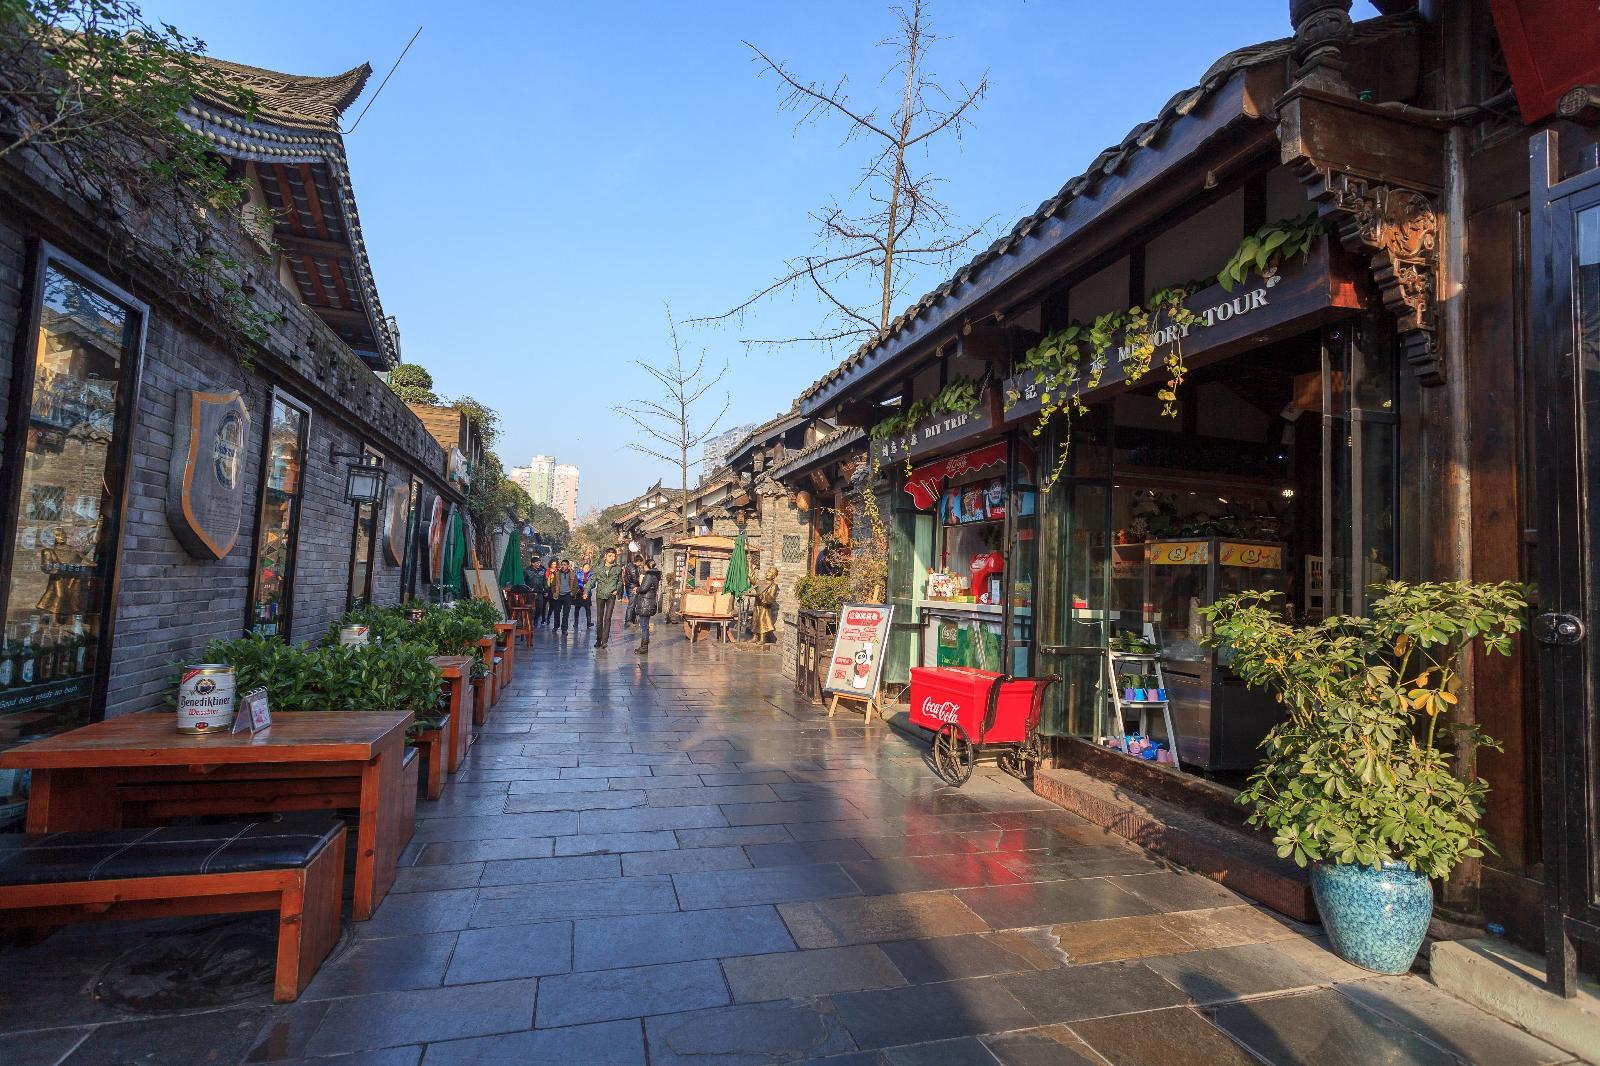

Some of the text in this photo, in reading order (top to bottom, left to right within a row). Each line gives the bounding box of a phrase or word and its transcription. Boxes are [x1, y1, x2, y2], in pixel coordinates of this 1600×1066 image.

[1117, 322, 1190, 363] MEORY
[1202, 288, 1270, 328] TOUR
[925, 423, 942, 439] DIY
[943, 413, 968, 431] TRIP
[180, 695, 230, 708] Benediktiner
[922, 696, 960, 723] Coca-Cola
